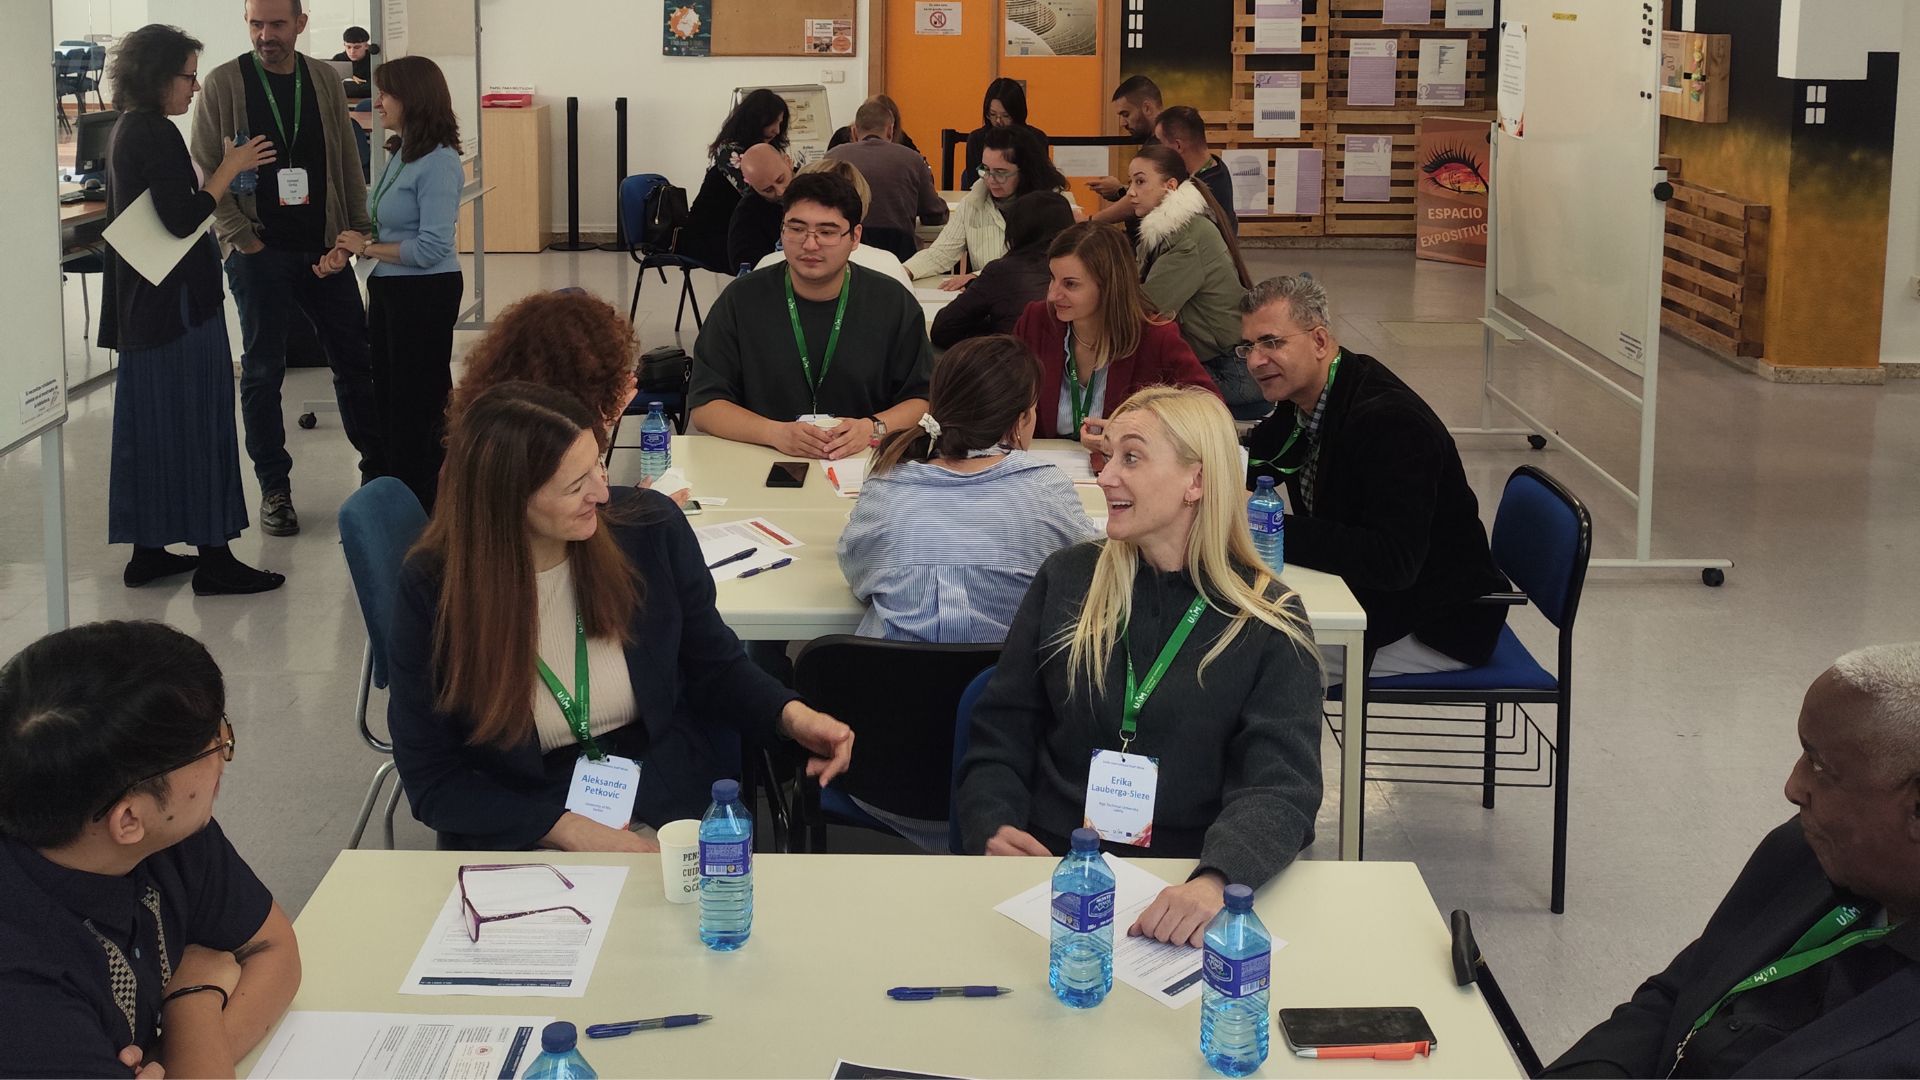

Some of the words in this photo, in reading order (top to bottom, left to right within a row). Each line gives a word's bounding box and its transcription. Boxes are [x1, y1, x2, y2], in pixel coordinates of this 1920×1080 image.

[1428, 207, 1483, 220] ESPACIO
[1420, 223, 1488, 248] EXPOSITIVO
[1187, 606, 1202, 624] UAM
[557, 690, 571, 710] UAM
[1132, 691, 1148, 709] UAM
[578, 721, 589, 740] UAM
[581, 774, 627, 790] Aleksandra
[1111, 776, 1132, 787] Erika
[584, 785, 621, 799] Petkovic
[683, 867, 699, 877] CUID
[1836, 906, 1861, 926] UAM
[1754, 966, 1777, 983] UAM
